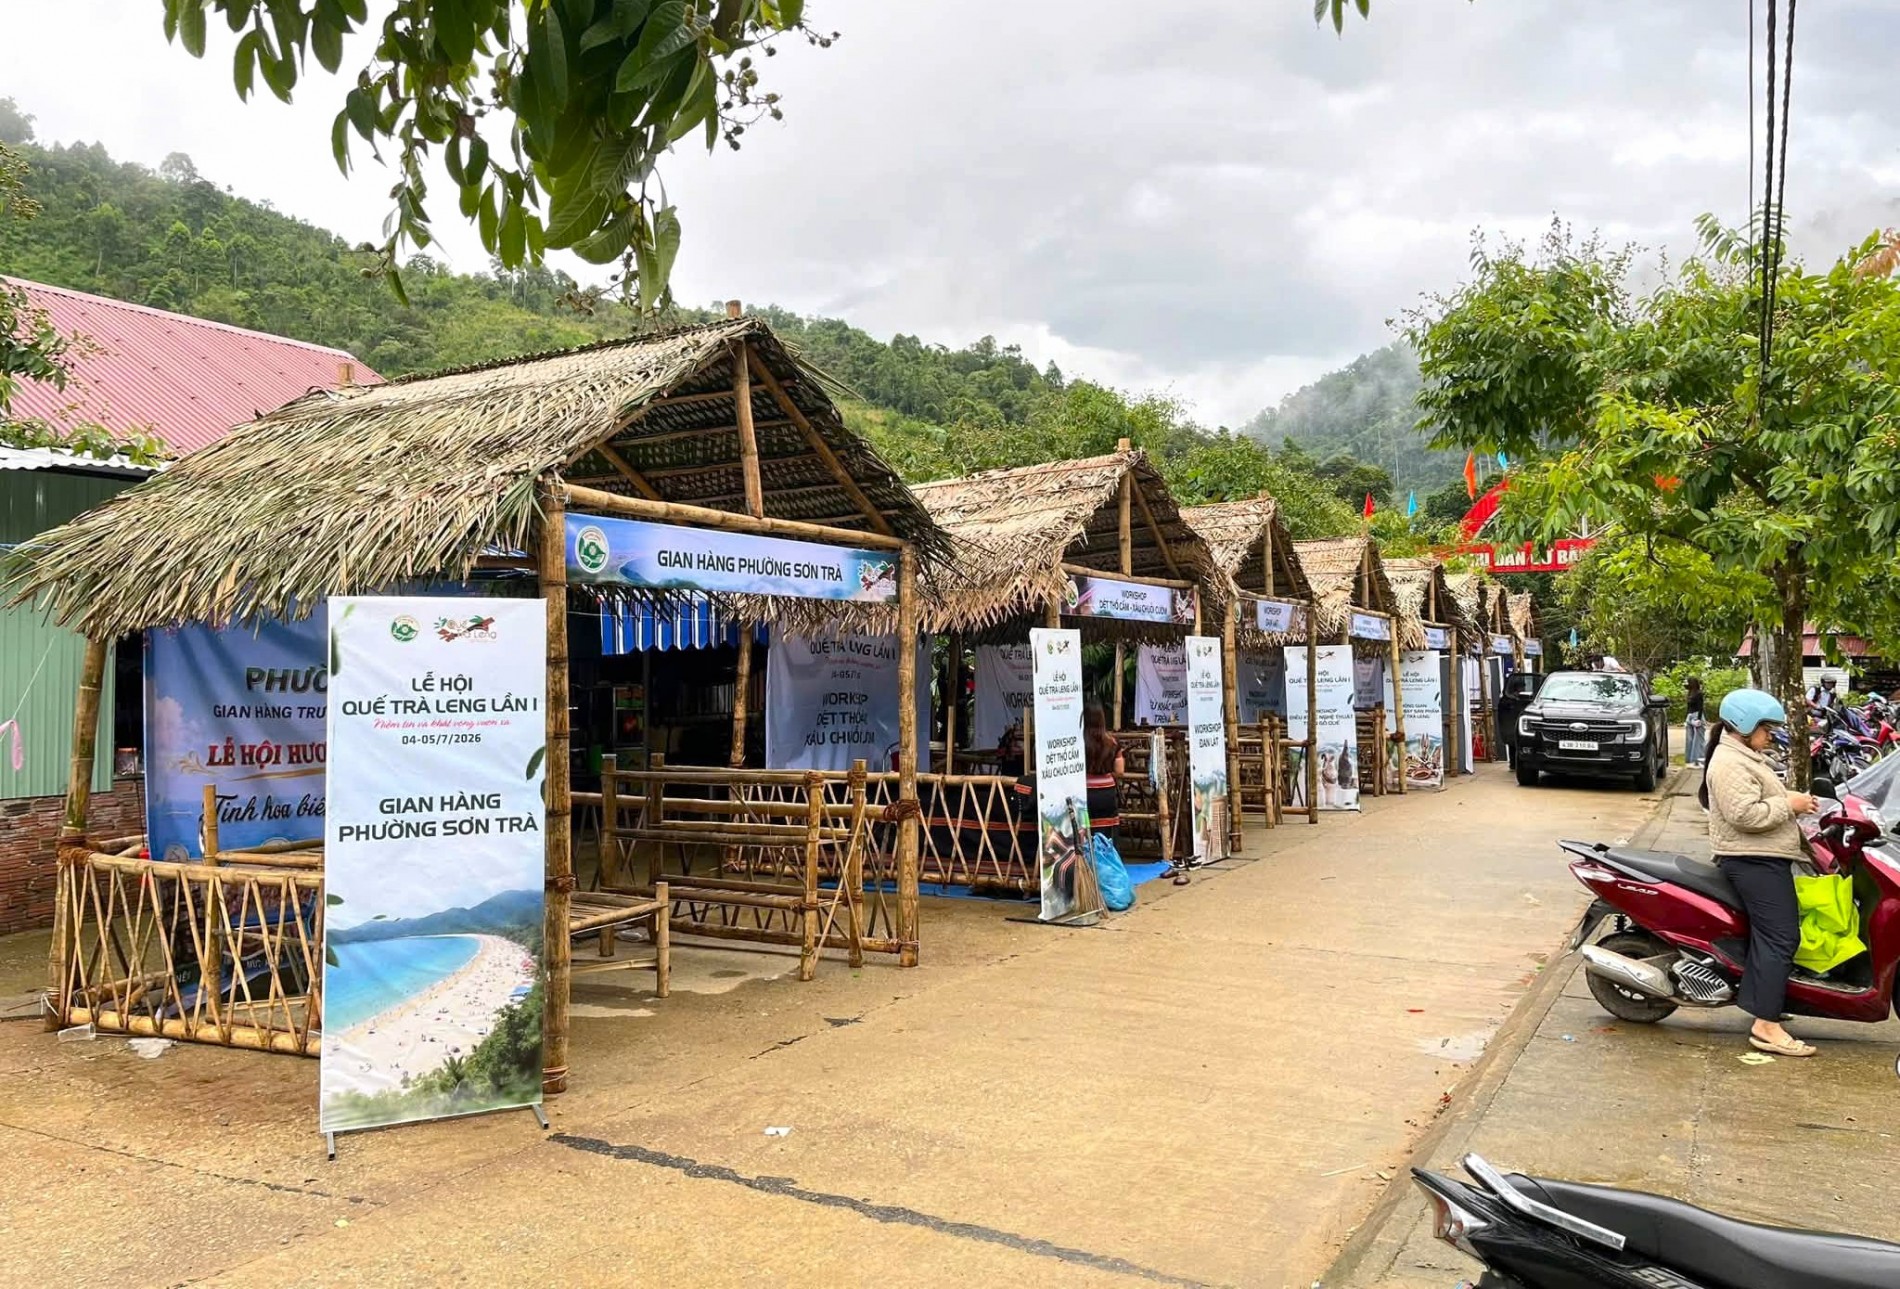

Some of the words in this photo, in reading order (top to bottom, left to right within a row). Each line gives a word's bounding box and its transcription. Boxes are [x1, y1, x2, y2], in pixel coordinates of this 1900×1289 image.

[657, 550, 693, 569] GIAN
[697, 550, 735, 572] HÀNG
[738, 556, 791, 577] PHƯỜNG
[794, 561, 818, 580] SƠN
[821, 563, 843, 582] TRÀ
[1122, 590, 1147, 600] WORKSHOP
[246, 663, 328, 693] PHƯỜ
[412, 671, 435, 692] LỄ
[440, 674, 472, 695] HỘI
[213, 704, 250, 718] GIAN
[255, 703, 292, 719] HÀNG
[342, 694, 387, 715] QUẾ
[390, 696, 431, 714] TRÀ
[435, 698, 486, 713] LENG
[491, 692, 528, 712] LẦN
[533, 698, 537, 711] I
[401, 733, 482, 745] 04-05/7/2026
[1194, 722, 1221, 734] WORKSHOP
[206, 736, 236, 766] LỄ
[240, 740, 282, 770] HỘI
[287, 742, 327, 765] HƯƠ
[1047, 736, 1077, 749] WORKSHOP
[260, 795, 293, 821] hoa
[379, 796, 433, 814] GIAN
[440, 791, 501, 812] HÀNG
[338, 818, 437, 842] PHƯỜNG
[442, 816, 490, 836] SƠN
[495, 812, 538, 832] TRÀ
[1617, 883, 1659, 895] LEAD
